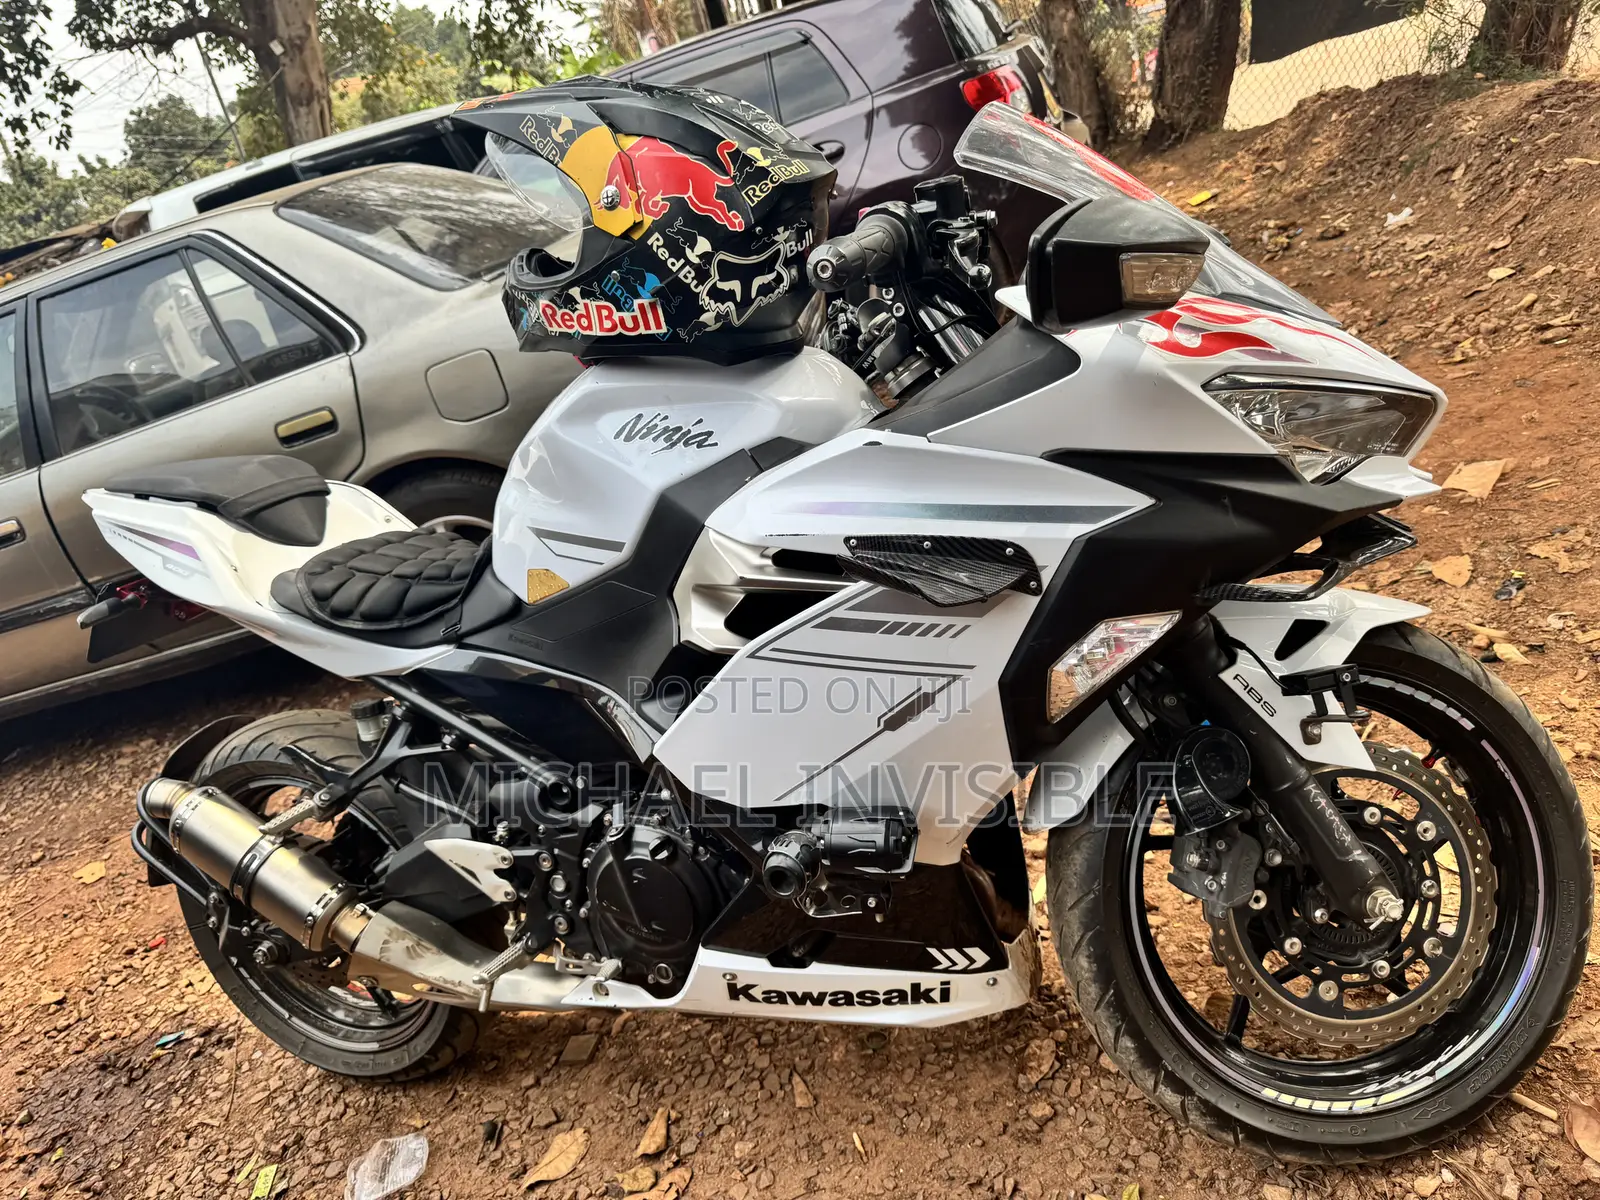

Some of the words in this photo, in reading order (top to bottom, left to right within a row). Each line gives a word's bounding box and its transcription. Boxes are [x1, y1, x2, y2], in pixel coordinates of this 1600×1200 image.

[613, 412, 719, 455] Ninja
[1233, 673, 1277, 718] ABS
[726, 979, 952, 1008] Kawasaki
[1468, 1027, 1529, 1095] DUNLOP
